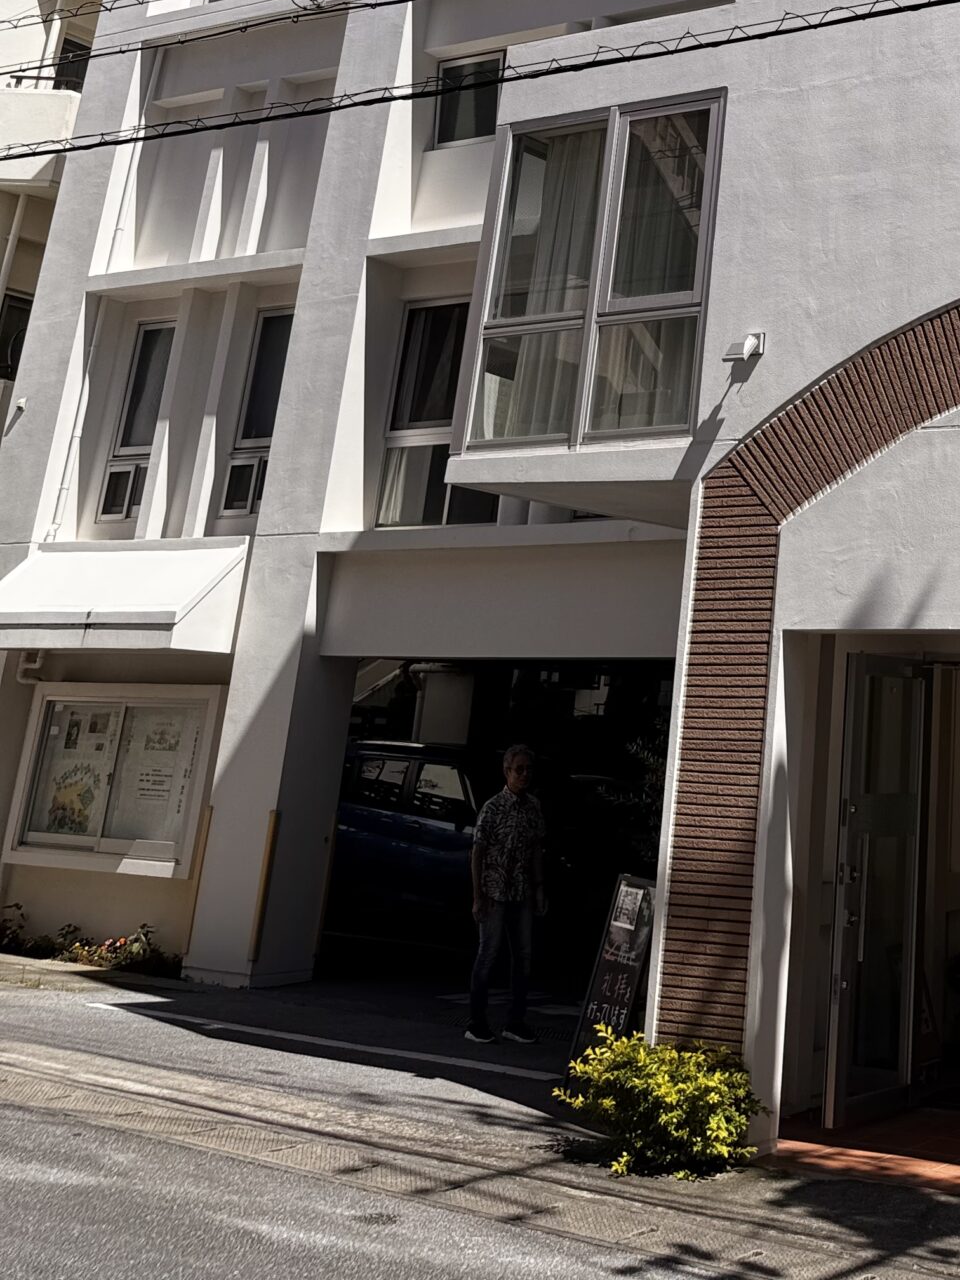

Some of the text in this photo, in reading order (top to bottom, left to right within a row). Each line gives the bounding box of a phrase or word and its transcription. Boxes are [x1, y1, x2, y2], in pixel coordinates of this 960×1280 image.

[586, 1001, 628, 1031] 行っています
